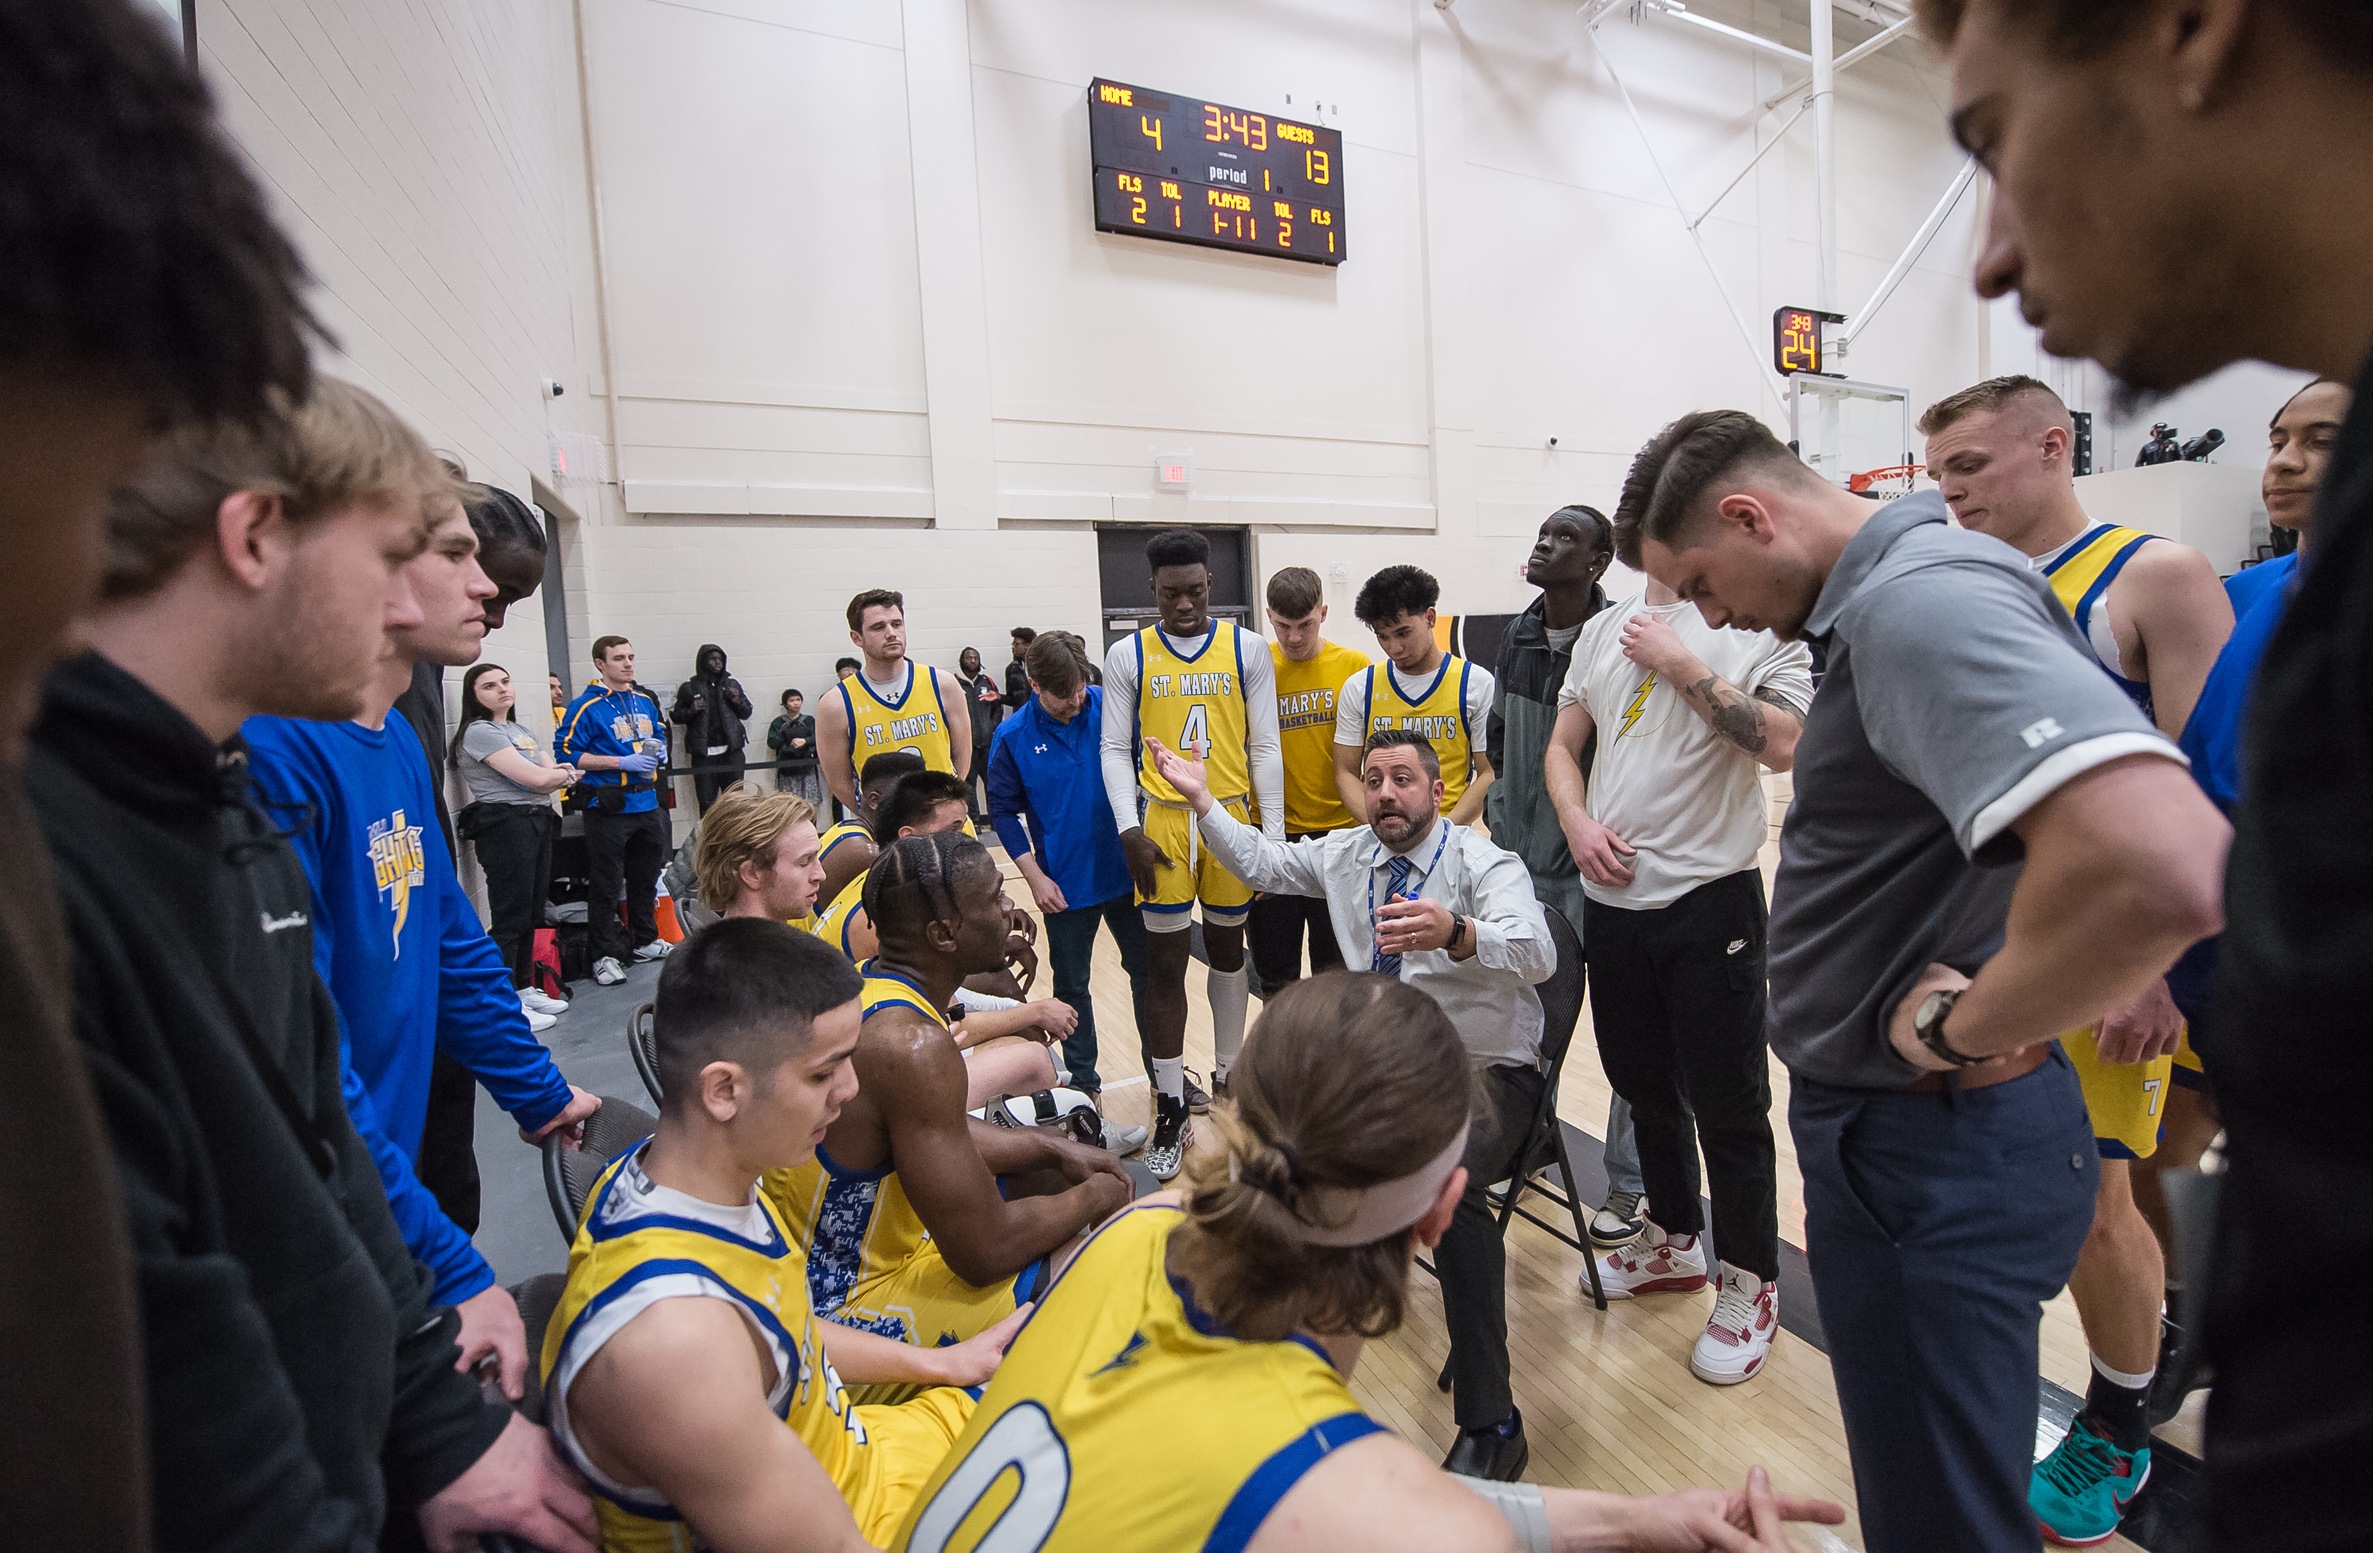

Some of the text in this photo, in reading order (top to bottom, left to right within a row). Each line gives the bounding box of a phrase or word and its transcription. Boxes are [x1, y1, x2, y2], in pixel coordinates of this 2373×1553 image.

[1100, 84, 1133, 107] HOME
[1141, 115, 1162, 151] 4
[1204, 104, 1267, 151] 3:43
[1276, 123, 1315, 145] GUESTS
[1209, 165, 1271, 192] period 1
[1305, 149, 1330, 185] 13
[1118, 173, 1142, 193] FLS
[1160, 181, 1182, 201] TOL
[1131, 197, 1147, 225] 2
[1208, 190, 1251, 212] PLAYER
[1273, 201, 1293, 220] TOL
[1174, 205, 1181, 228] 1
[1310, 208, 1332, 226] FLS
[1278, 221, 1292, 247] 2
[1328, 231, 1335, 253] 1
[1782, 329, 1816, 370] 24
[1150, 672, 1231, 698] ST. MARY'S
[1279, 690, 1334, 716] MARY'S
[864, 712, 938, 746] ST. MARY'S
[1179, 703, 1212, 759] 4
[1279, 711, 1335, 730] BASKETBALL
[2143, 1078, 2162, 1116] 7
